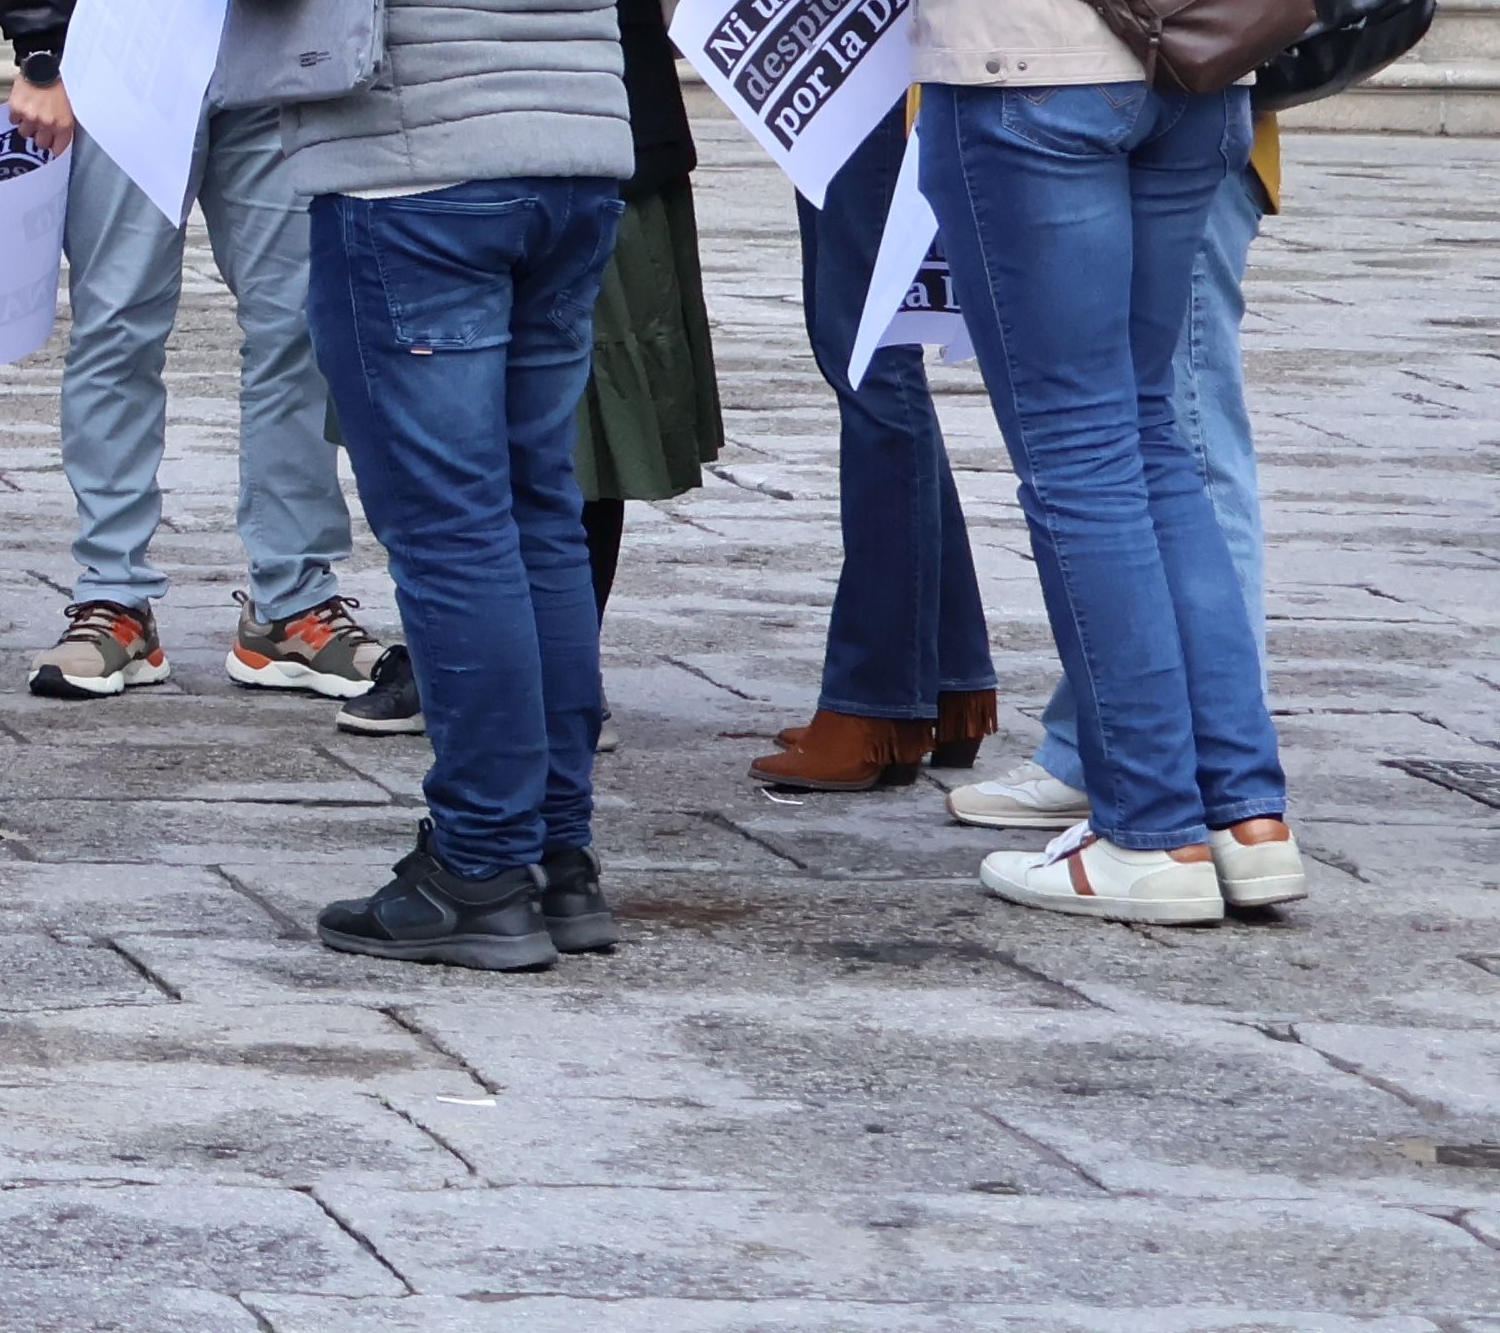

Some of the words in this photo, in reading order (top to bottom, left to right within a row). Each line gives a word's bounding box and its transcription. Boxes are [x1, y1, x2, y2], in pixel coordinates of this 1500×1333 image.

[710, 11, 758, 70] Ni
[774, 64, 832, 137] por
[821, 29, 868, 74] la
